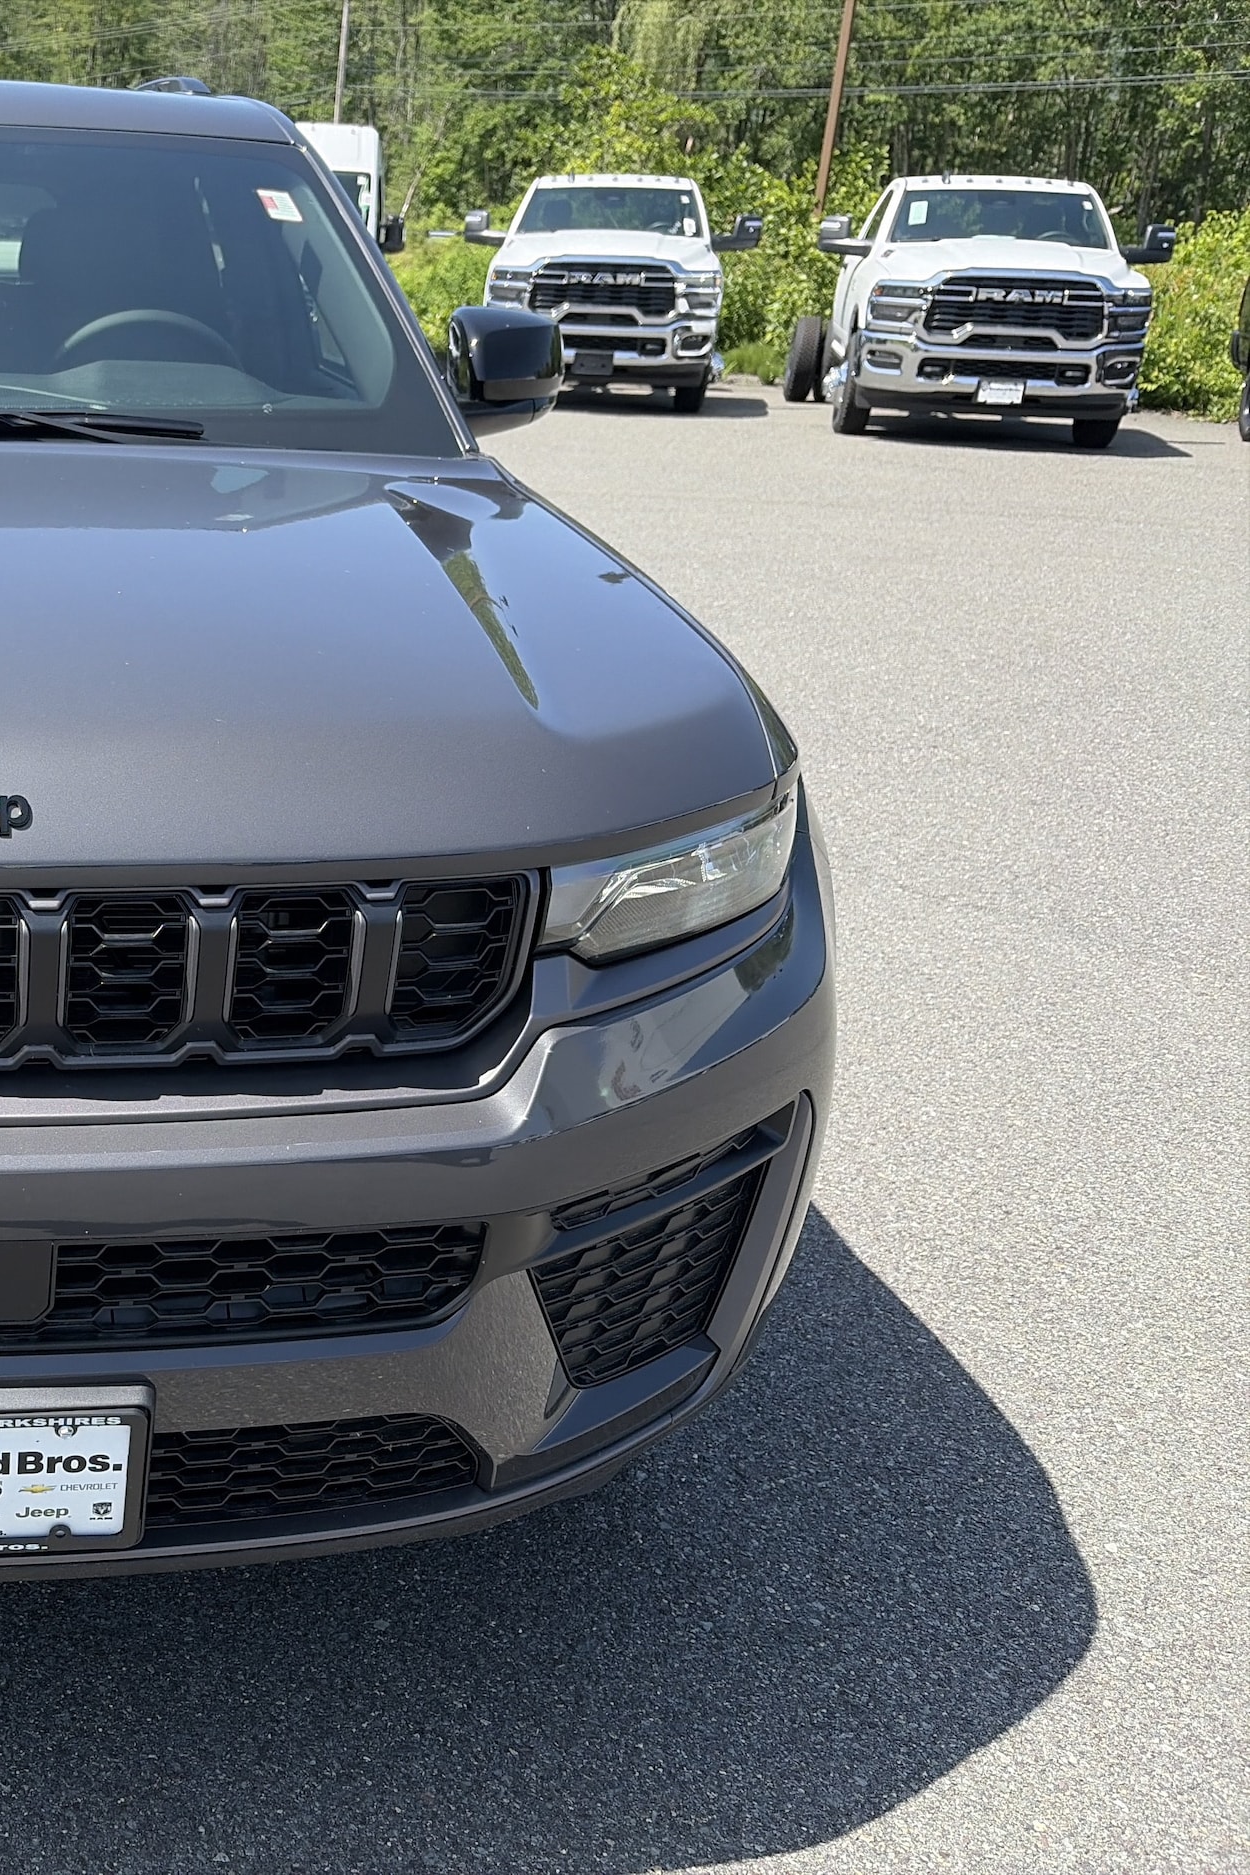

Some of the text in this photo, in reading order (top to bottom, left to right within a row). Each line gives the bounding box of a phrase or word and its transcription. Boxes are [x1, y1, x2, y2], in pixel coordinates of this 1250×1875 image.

[977, 287, 1063, 304] RAM
[17, 1451, 123, 1475] Bros.
[60, 1482, 118, 1492] CHEVROLET
[15, 1507, 69, 1518] Jeep
